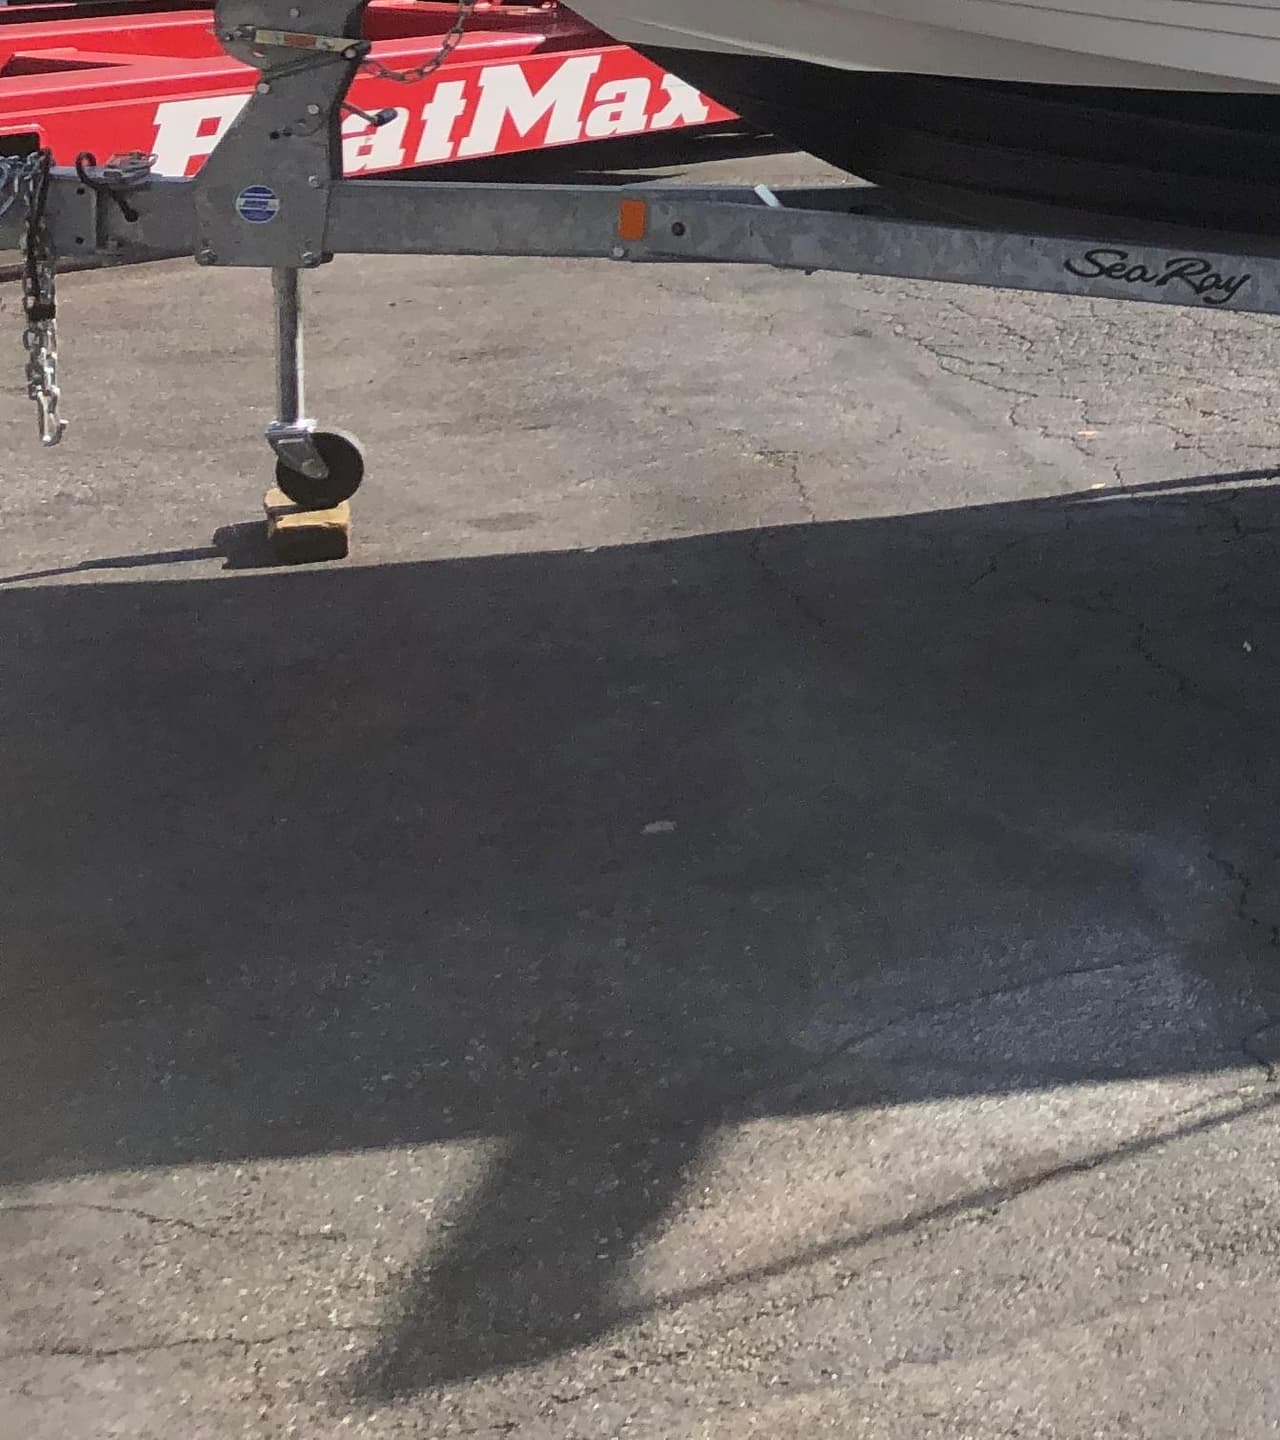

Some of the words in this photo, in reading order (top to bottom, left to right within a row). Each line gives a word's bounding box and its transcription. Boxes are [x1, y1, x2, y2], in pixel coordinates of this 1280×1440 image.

[152, 54, 712, 178] BatMax
[1063, 248, 1159, 284] Sea
[1155, 256, 1252, 305] Ray
